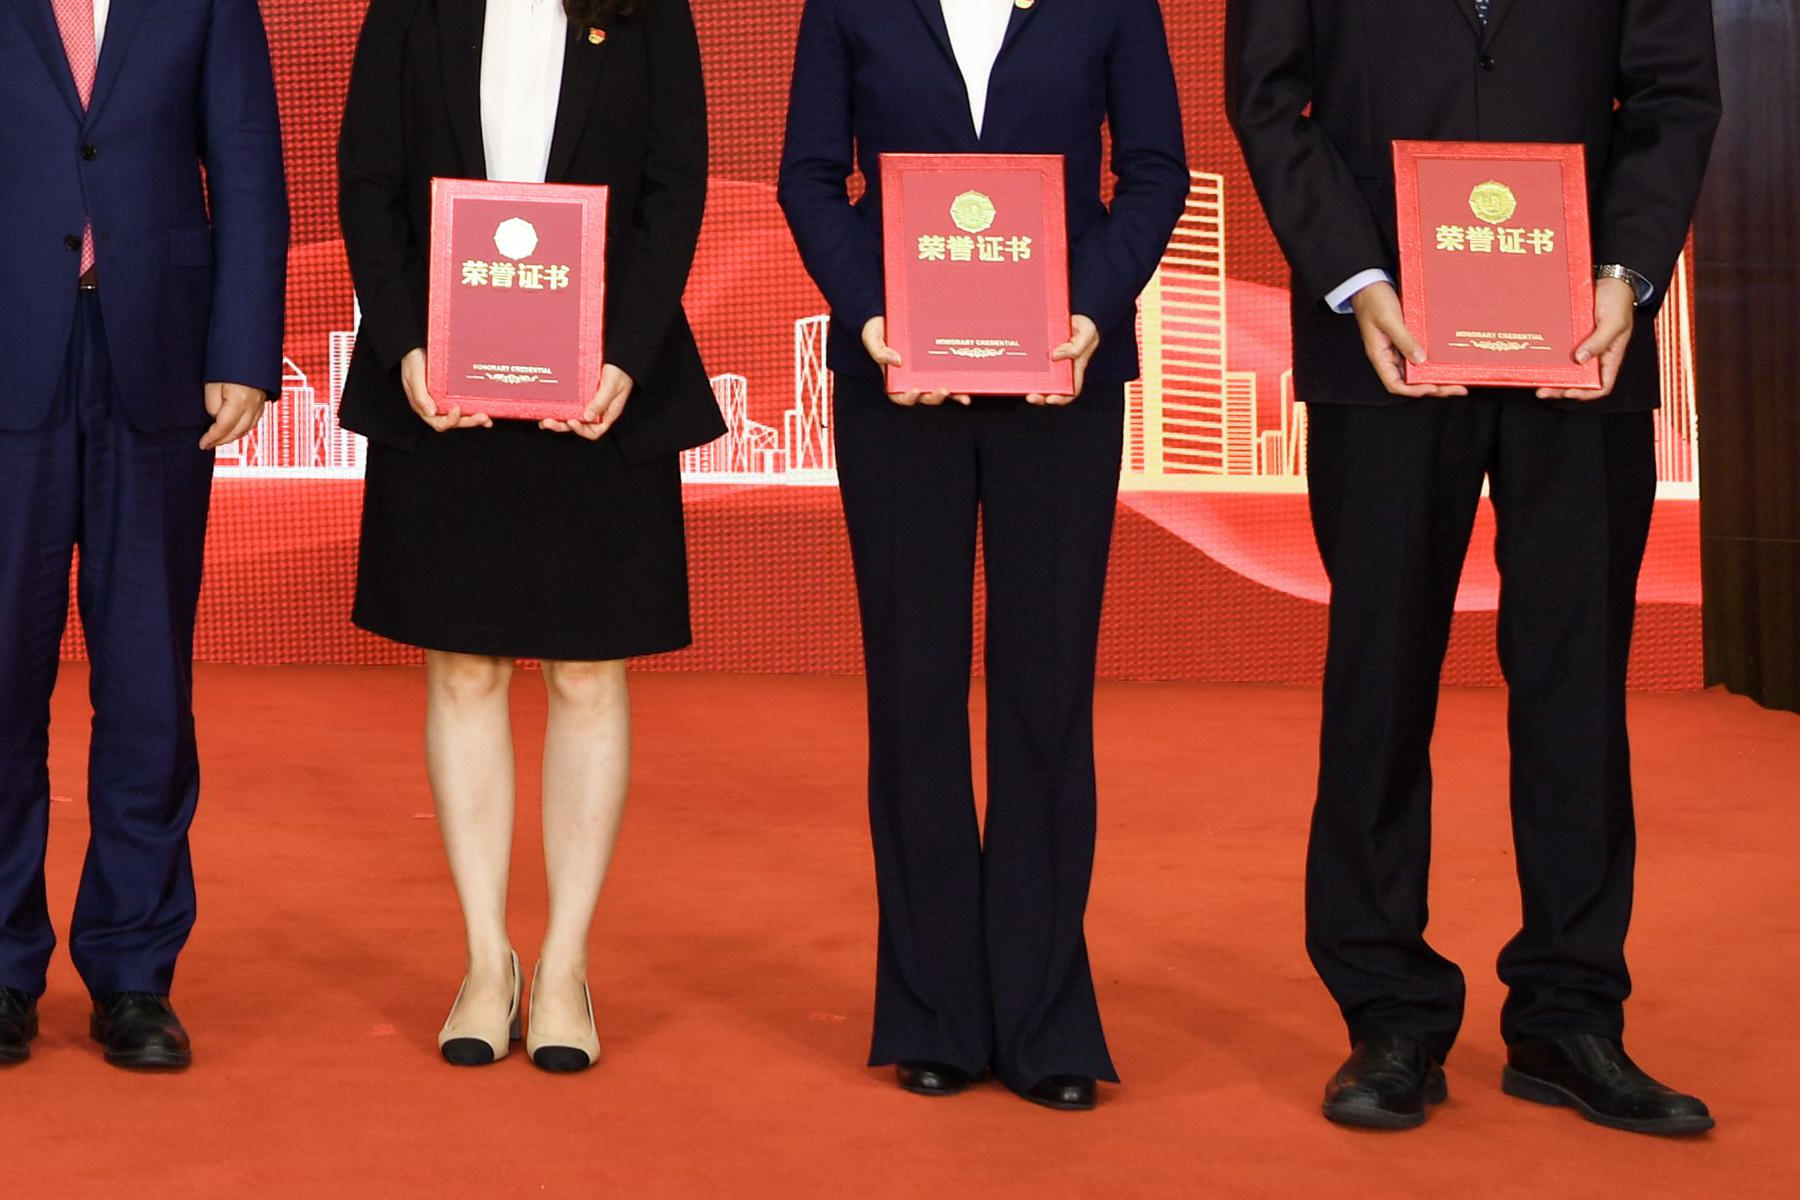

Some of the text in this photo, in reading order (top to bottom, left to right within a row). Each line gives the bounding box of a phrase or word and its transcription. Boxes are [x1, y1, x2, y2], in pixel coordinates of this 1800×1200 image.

[918, 235, 1032, 262] 荣誉证书
[1435, 225, 1554, 254] 荣誉证书
[462, 260, 570, 290] 荣誉证书
